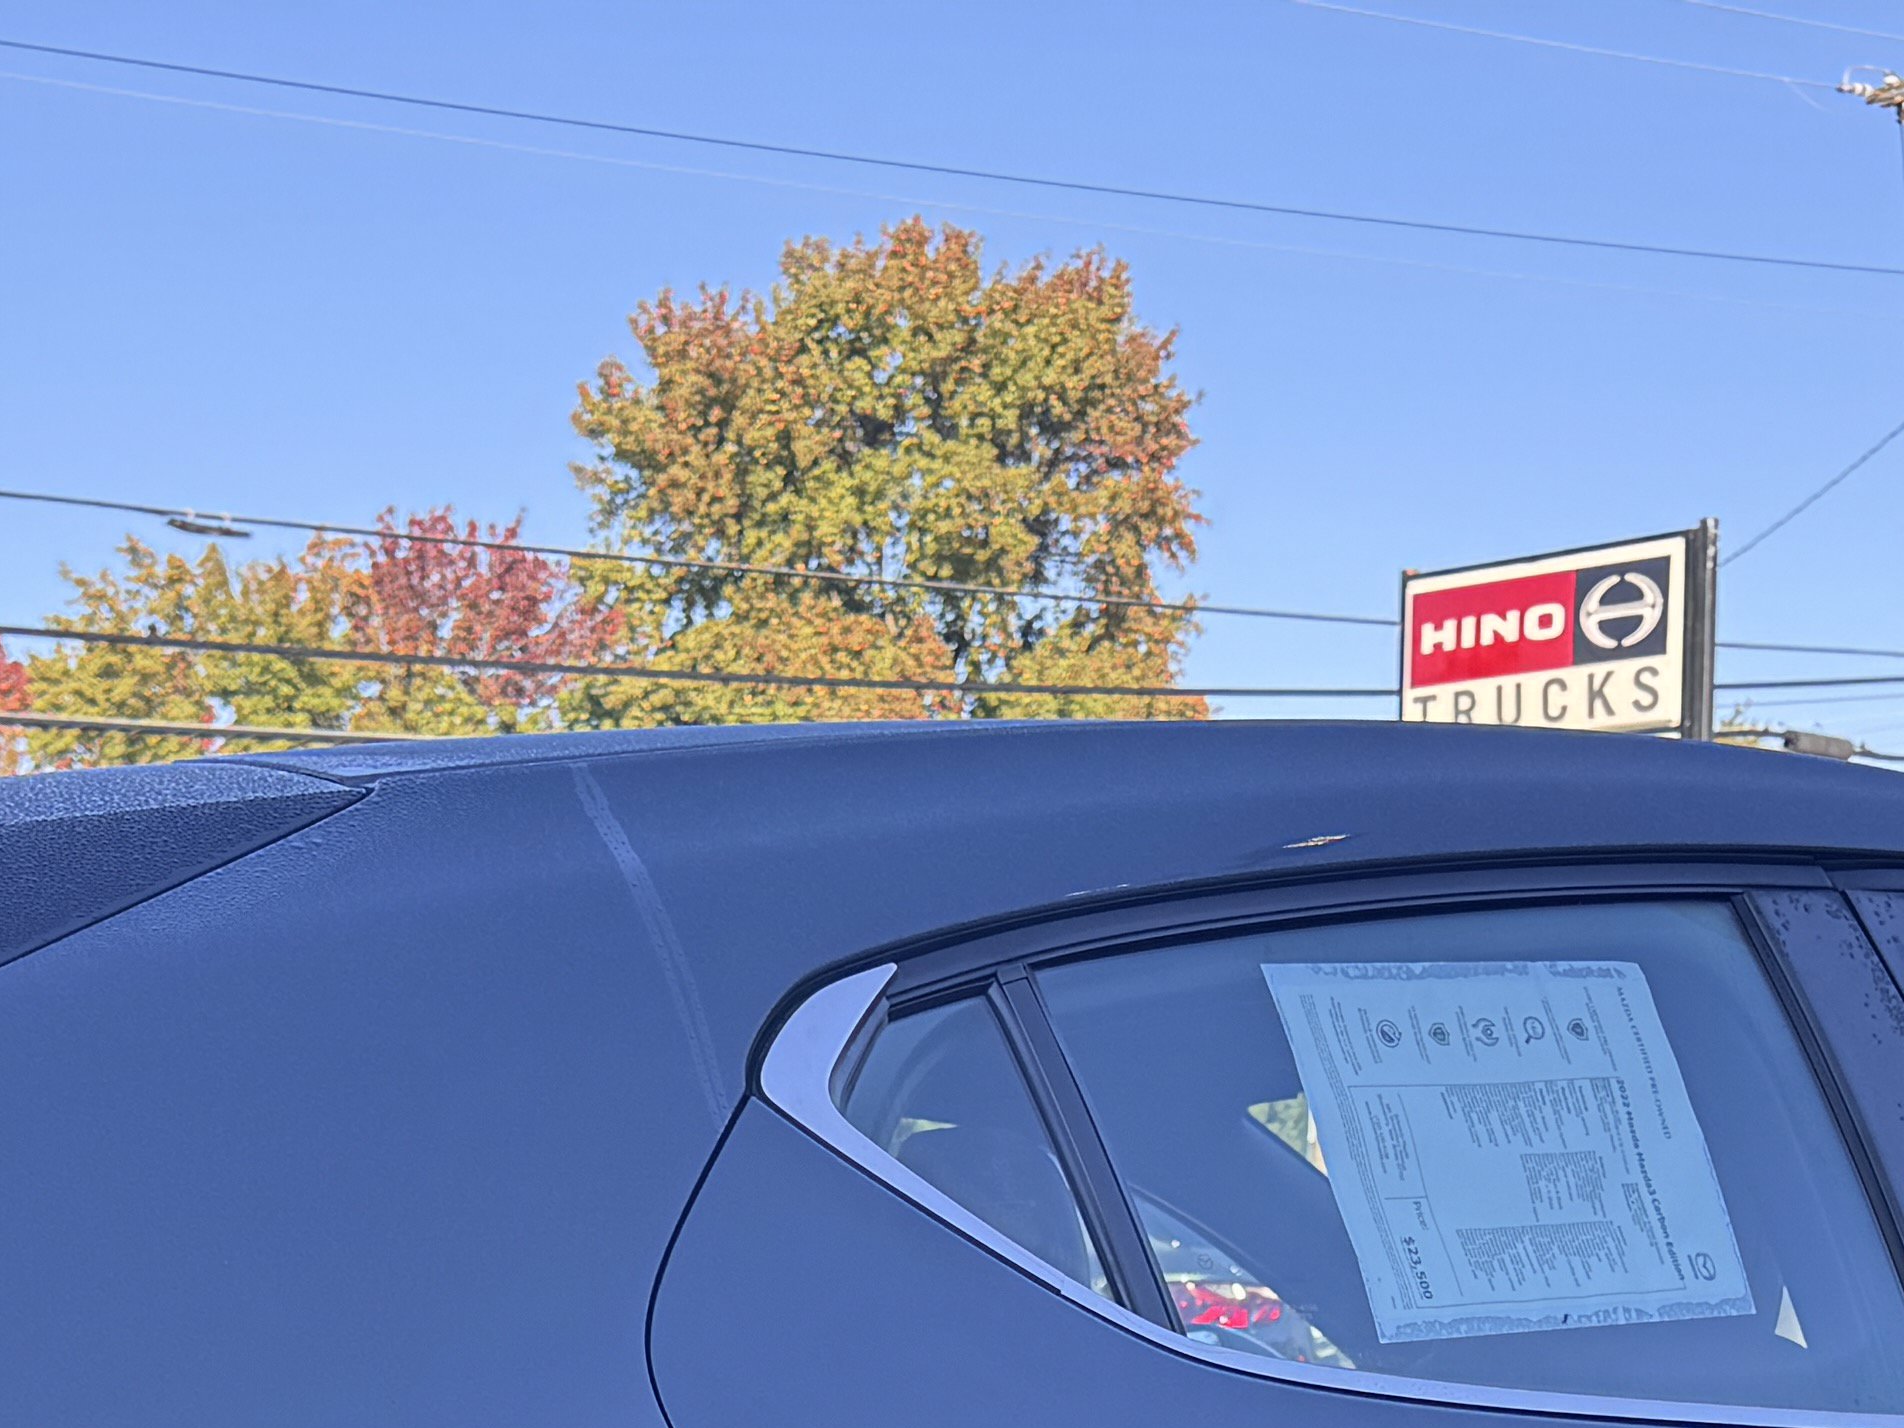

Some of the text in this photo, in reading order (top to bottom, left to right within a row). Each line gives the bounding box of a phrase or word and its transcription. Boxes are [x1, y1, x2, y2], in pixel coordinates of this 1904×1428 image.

[1419, 601, 1566, 656] HINO
[1412, 665, 1660, 724] TRUCKS
[1616, 1079, 1630, 1108] 2022
[1652, 1199, 1670, 1239] Carbon
[1666, 1242, 1685, 1281] Edition
[1402, 1236, 1435, 1299] $23,500
